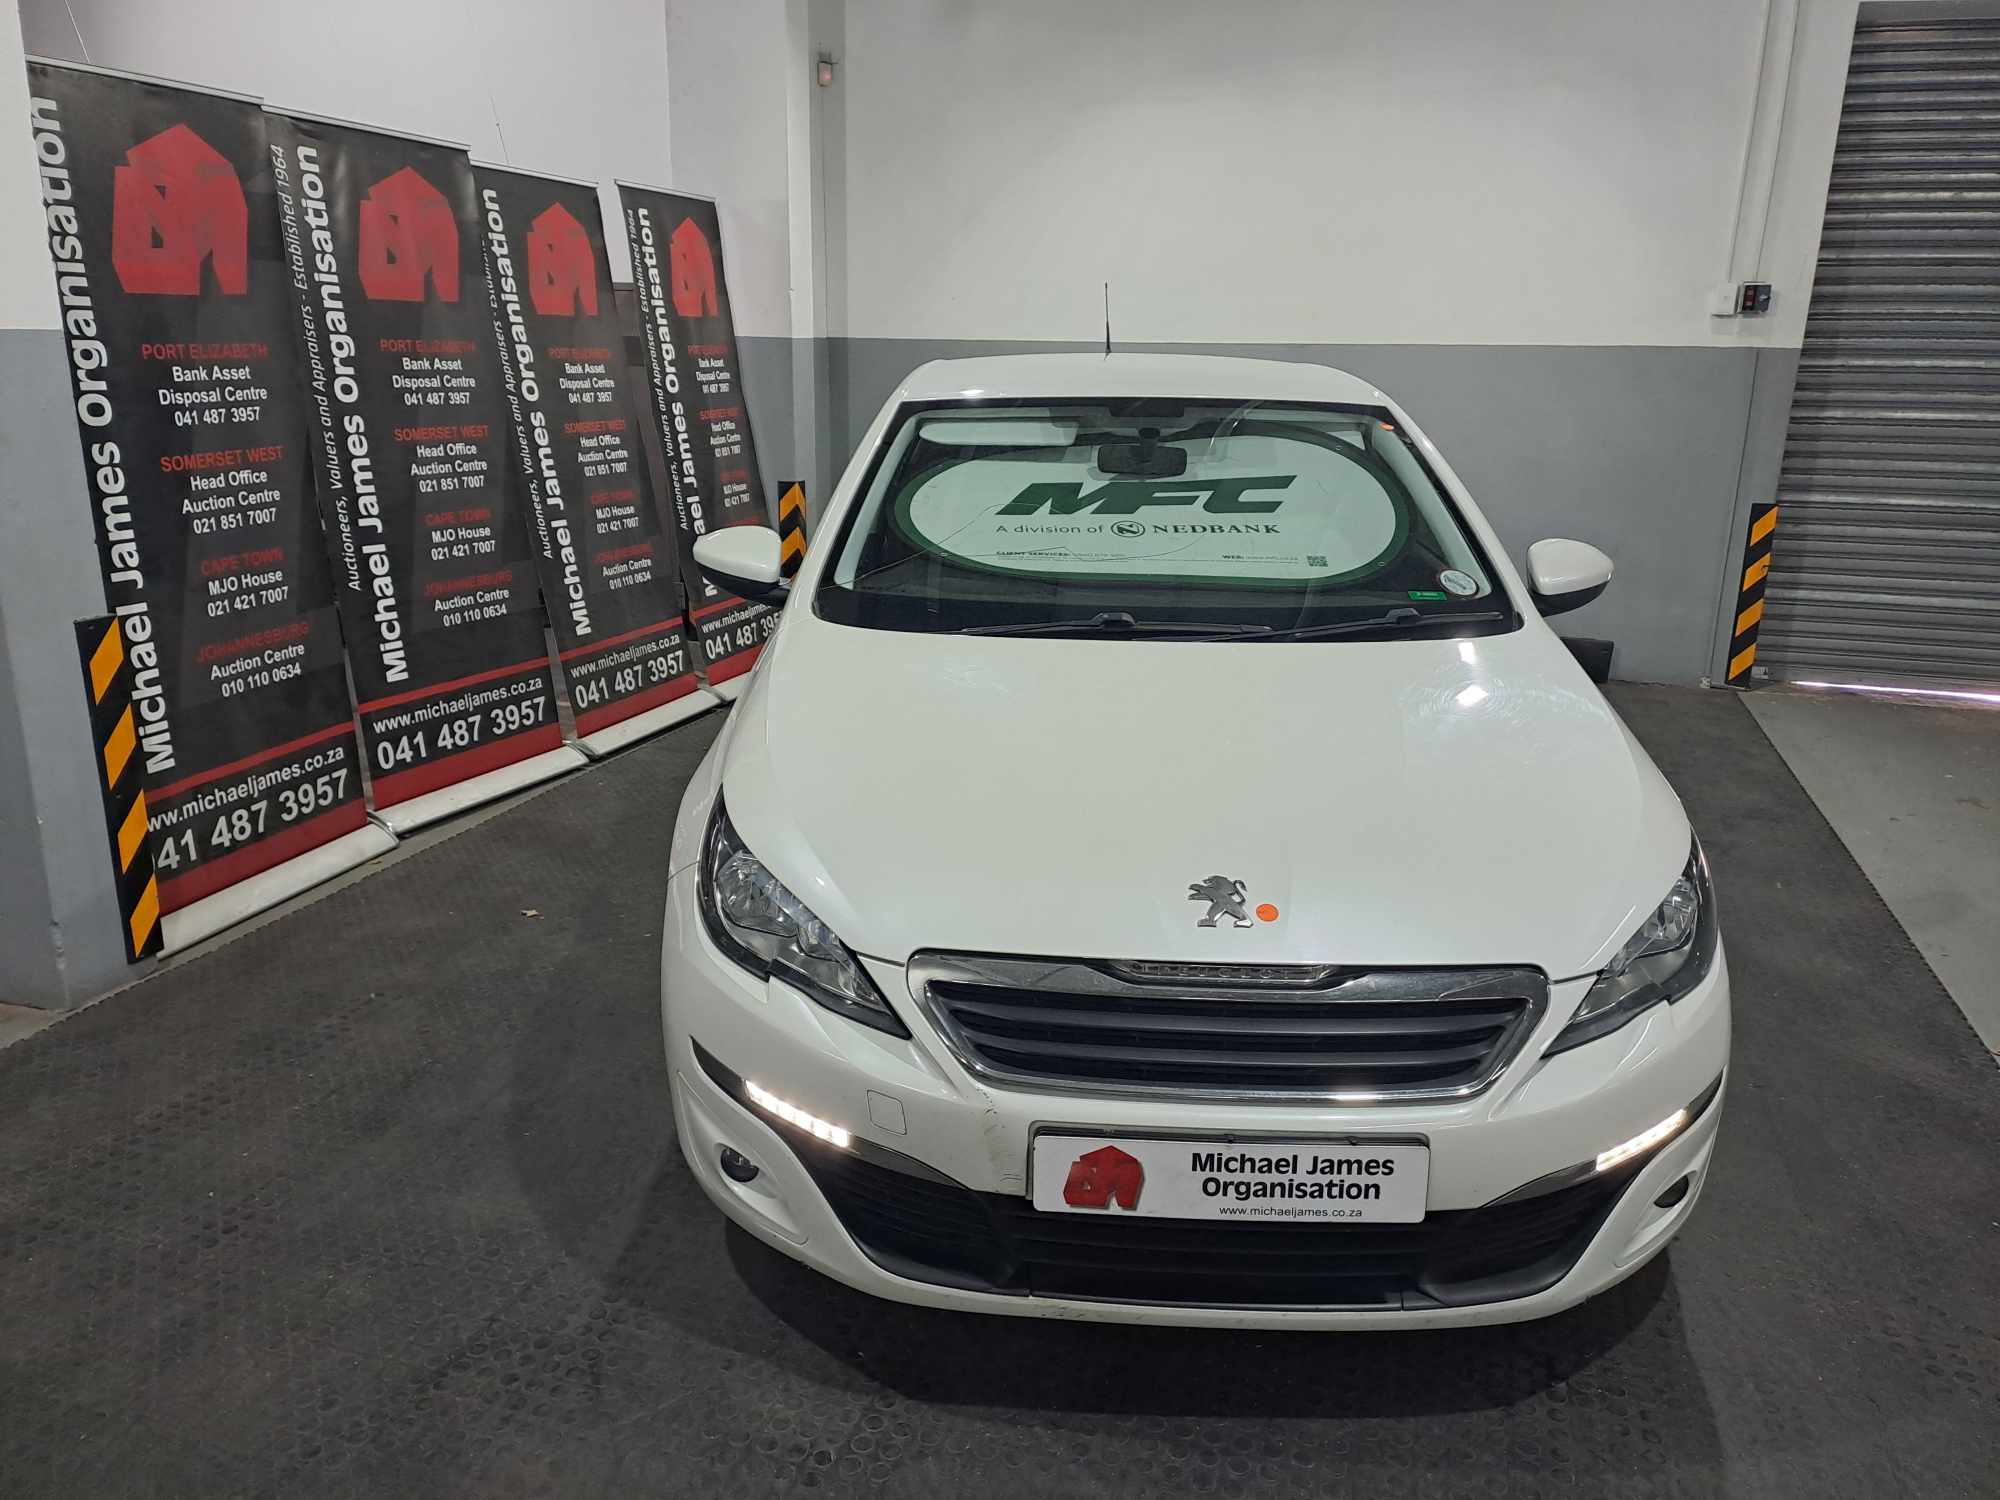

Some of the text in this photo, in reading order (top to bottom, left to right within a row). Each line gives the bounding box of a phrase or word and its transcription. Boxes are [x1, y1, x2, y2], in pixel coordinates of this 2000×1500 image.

[270, 143, 290, 190] 1964
[279, 190, 308, 291] Established
[482, 188, 539, 402] Organisation
[637, 207, 679, 394] Organisation
[141, 343, 185, 360] PORT
[301, 303, 326, 392] Appraisers
[402, 357, 463, 371] Bank Asset
[493, 320, 517, 393] Appraisers
[645, 323, 662, 386] Appraisers
[171, 365, 252, 382] Bank Asset
[392, 375, 476, 391] Disposal Centre
[158, 386, 268, 408] Disposal Centre
[312, 393, 333, 427] and
[404, 391, 470, 406] 041 487 3957
[507, 395, 522, 422] and
[654, 388, 667, 412] and
[174, 406, 261, 427] 041 487 3957
[297, 145, 409, 684] Michael James Organisation
[31, 96, 176, 775] Michael James Organisation
[416, 442, 477, 458] Head Office
[517, 424, 534, 475] Valuers
[662, 414, 674, 457] Valuers
[672, 401, 698, 488] James
[160, 446, 284, 473] SOMERSET WEST
[324, 430, 343, 490] Valuers
[411, 460, 488, 476] Auction Centre
[530, 410, 564, 510] James
[190, 469, 268, 492] Head Office
[419, 475, 485, 493] 021 851 7007
[995, 475, 1298, 516] MFC
[182, 488, 281, 515] Auction Centre
[193, 507, 278, 535] 021 851 7007
[431, 526, 492, 544] MJO House
[528, 479, 553, 559] Auctioneers,
[996, 524, 1281, 534] A division of NEDBANK
[335, 495, 362, 592] Auctioneers,
[431, 540, 496, 561] 021 421 7007
[208, 570, 284, 596] MJO House
[551, 518, 593, 637] Michael
[602, 558, 652, 577] Auction Centre
[207, 586, 289, 617] 021 421 7007
[434, 588, 510, 612] Auction Centre
[442, 603, 508, 627] 010 110 0634
[570, 633, 680, 679] www.michaeljames.co.za
[705, 632, 732, 660] 041
[736, 621, 758, 647] 487
[210, 643, 306, 681] Auction Centre
[221, 661, 302, 698] 010 110 0634
[575, 650, 683, 709] 041 487 3957
[372, 677, 543, 735] www.michaeljames.co.za
[377, 695, 546, 771] 041 487 3957
[147, 746, 344, 833] ww.michaeljames.co.za
[152, 767, 349, 872] 41 487 3957
[1191, 1152, 1395, 1176] Michael James
[1202, 1176, 1381, 1201] Organisation
[1219, 1206, 1363, 1219] www.michaeljames.co.za
